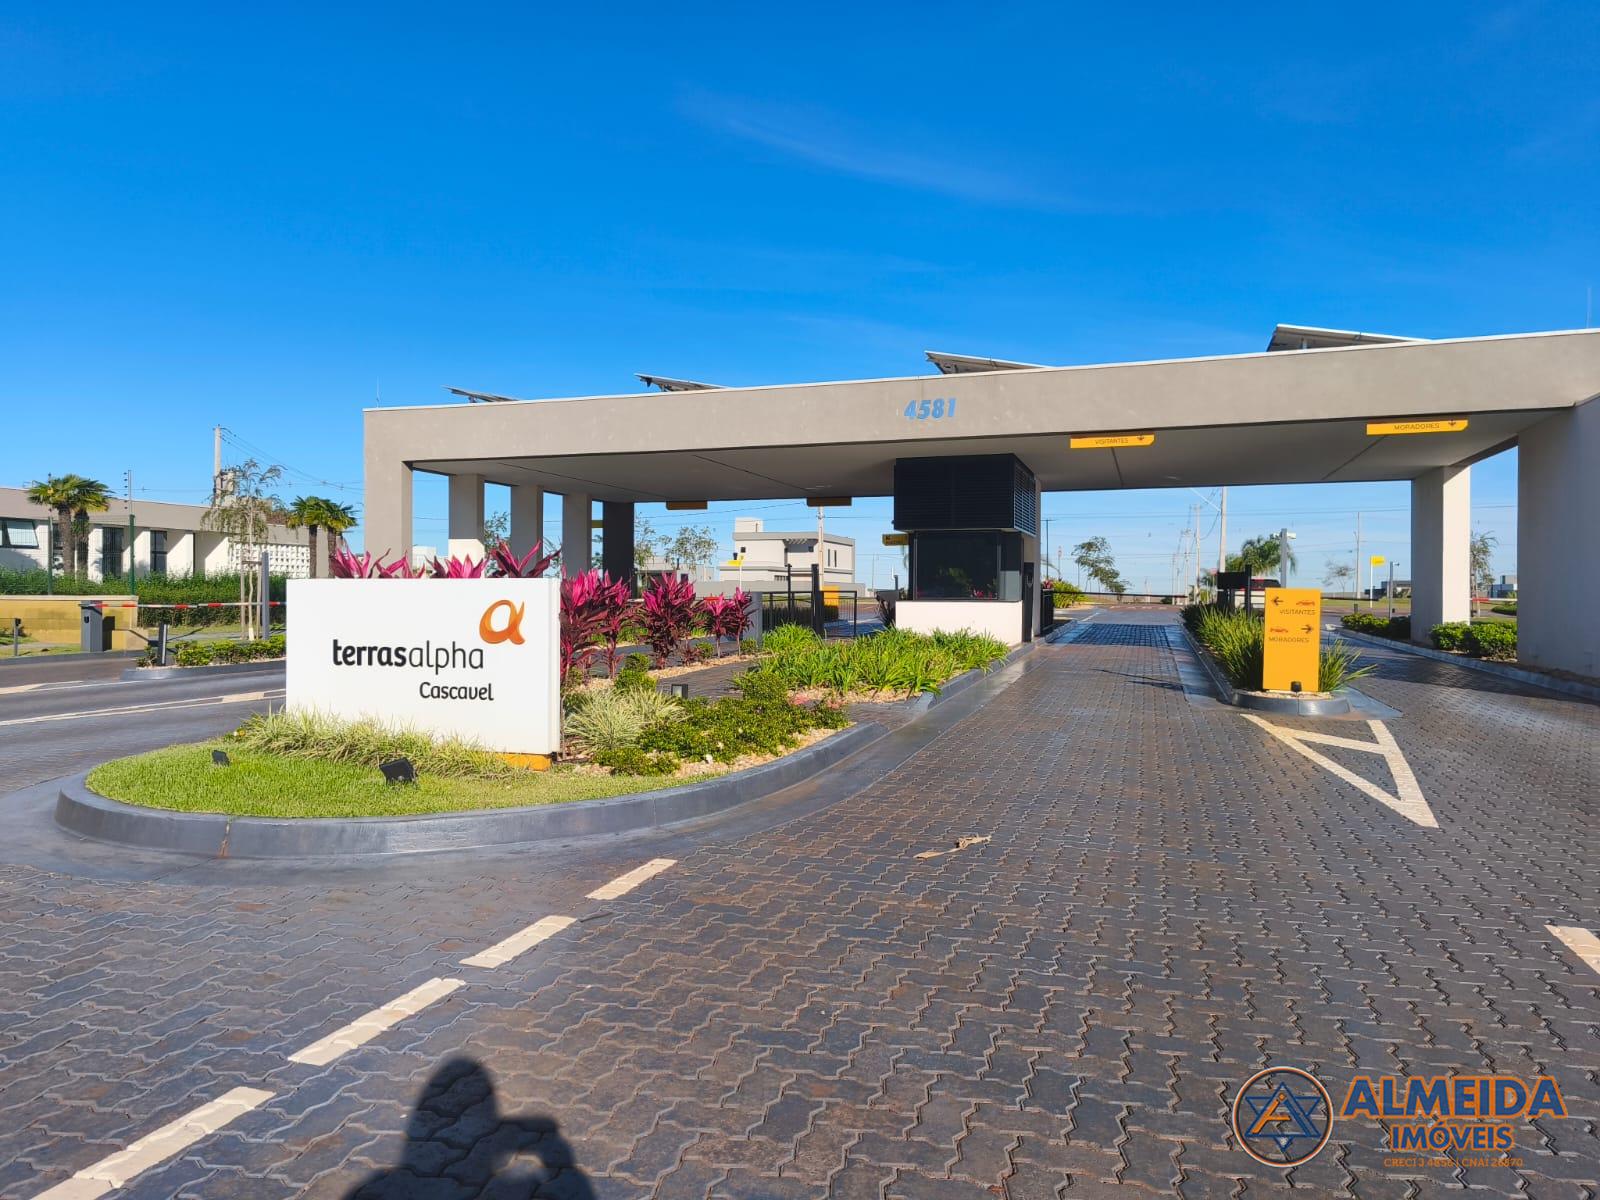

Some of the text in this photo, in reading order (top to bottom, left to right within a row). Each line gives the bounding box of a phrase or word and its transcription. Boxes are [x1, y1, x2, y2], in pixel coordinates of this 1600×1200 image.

[903, 397, 956, 420] 4581
[1393, 422, 1440, 431] MORADORES
[1095, 437, 1129, 445] VISITANTES
[1268, 636, 1310, 644] MORADORES
[332, 638, 484, 676] terrasalpha
[419, 681, 494, 701] Cascavel
